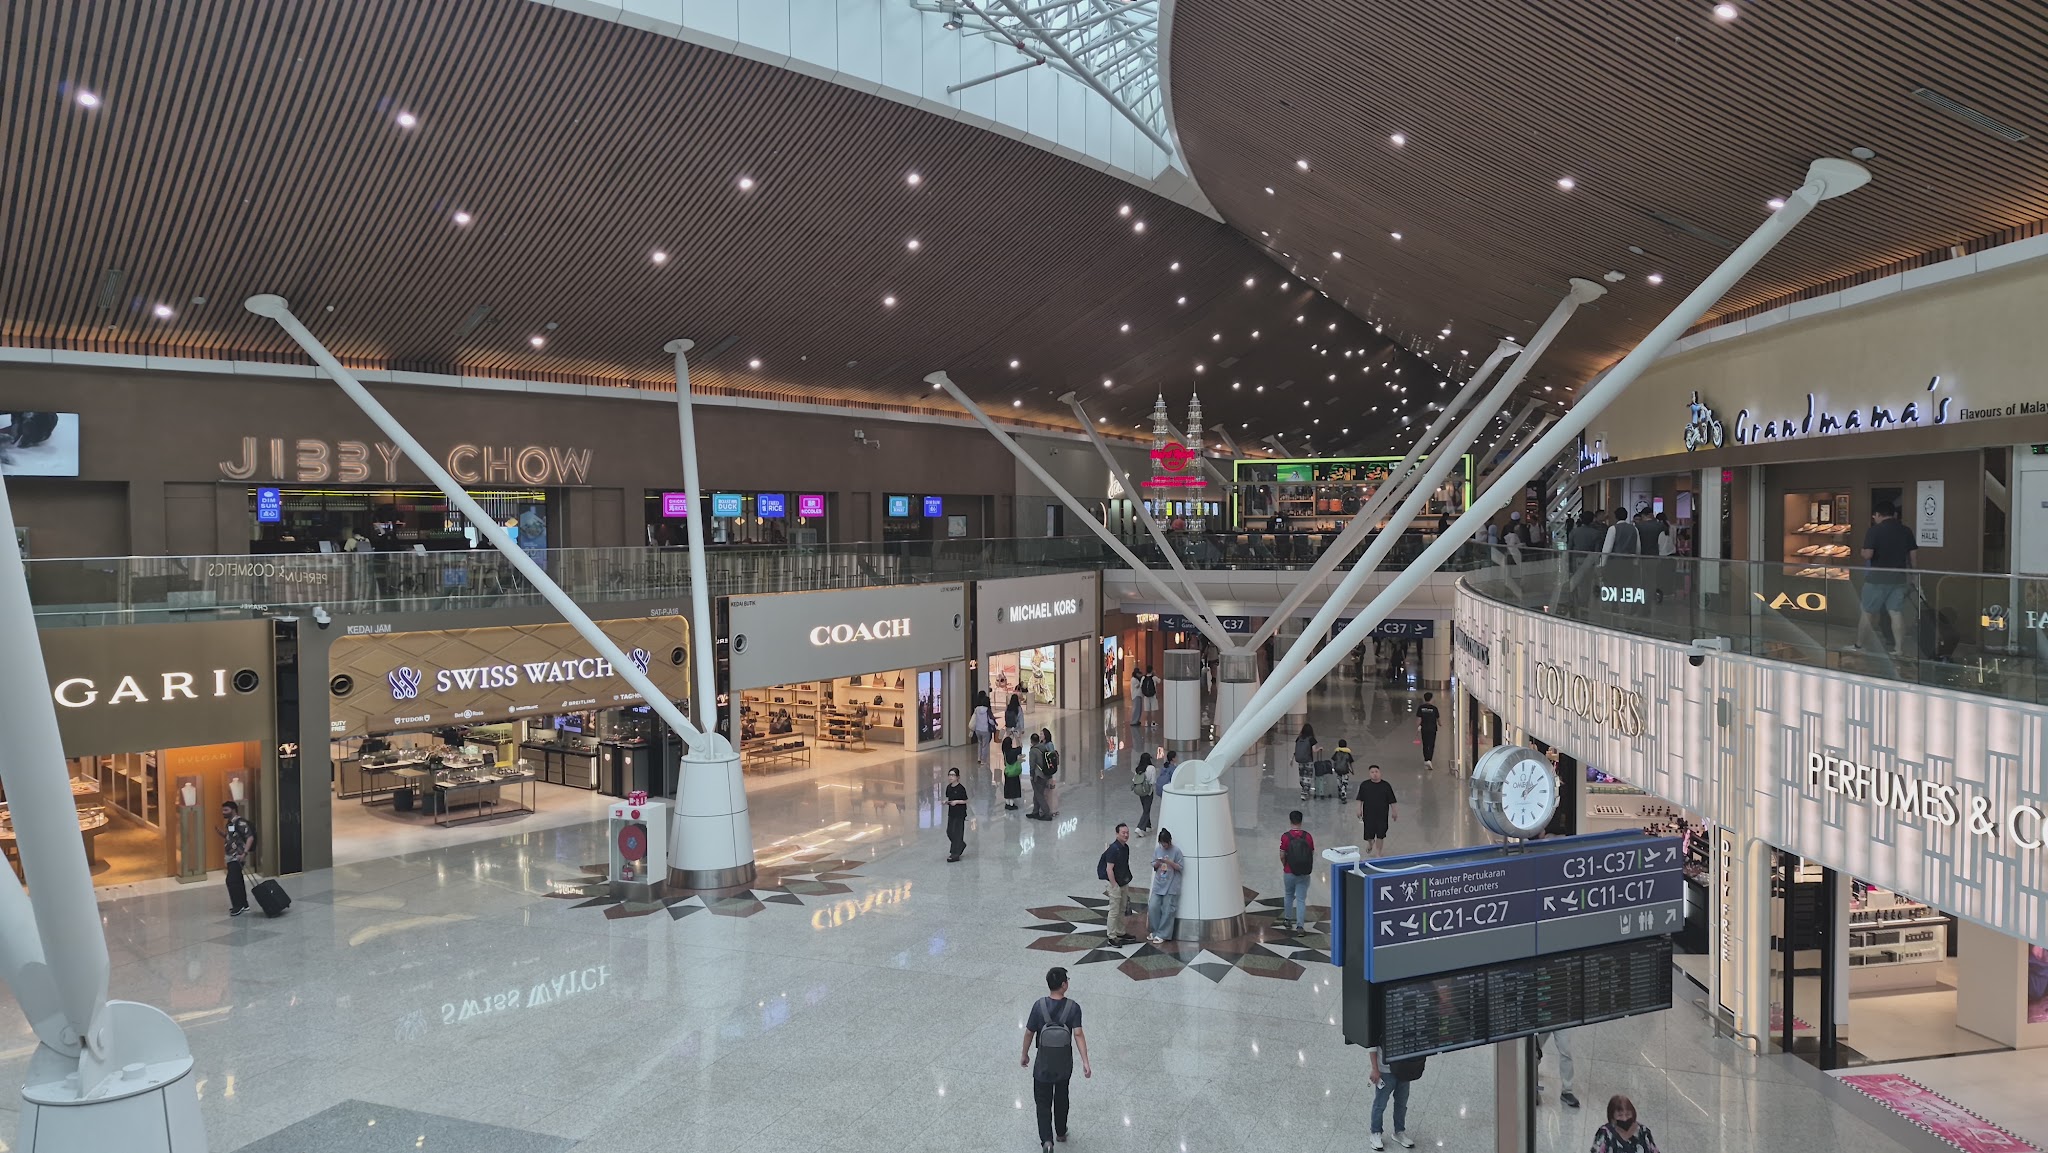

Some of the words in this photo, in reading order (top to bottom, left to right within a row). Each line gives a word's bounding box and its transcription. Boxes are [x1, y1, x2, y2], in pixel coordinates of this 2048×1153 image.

[1735, 376, 1952, 445] Grandmama's
[1960, 408, 2002, 420] Flavours
[2005, 403, 2016, 415] of
[219, 437, 402, 482] JIBBY
[448, 444, 593, 484] CHOW
[1921, 532, 1938, 540] HALAL
[1009, 602, 1052, 623] MICHAEL
[1053, 598, 1076, 616] KORS
[347, 626, 373, 634] KEDAI
[374, 624, 392, 633] JAM
[809, 617, 911, 646] COACH
[437, 664, 519, 692] SWISS
[523, 657, 614, 684] WATCH
[568, 698, 596, 707] BREITLING
[1536, 661, 1643, 737] COLOURS
[401, 716, 424, 724] TUDOR
[1808, 752, 1960, 827] PERFUMES
[1969, 795, 1999, 838] &
[2008, 804, 2048, 850] C
[1429, 875, 1461, 887] Kaunter
[1462, 869, 1506, 882] Pertukaran
[1563, 850, 1636, 879] C31-C37
[1722, 839, 1731, 897] DUTY
[1429, 886, 1462, 898] Transfer
[1463, 882, 1499, 893] Counters
[1587, 879, 1655, 907] C11-C17
[1429, 901, 1509, 932] C21-C27
[1722, 903, 1730, 962] FREE
